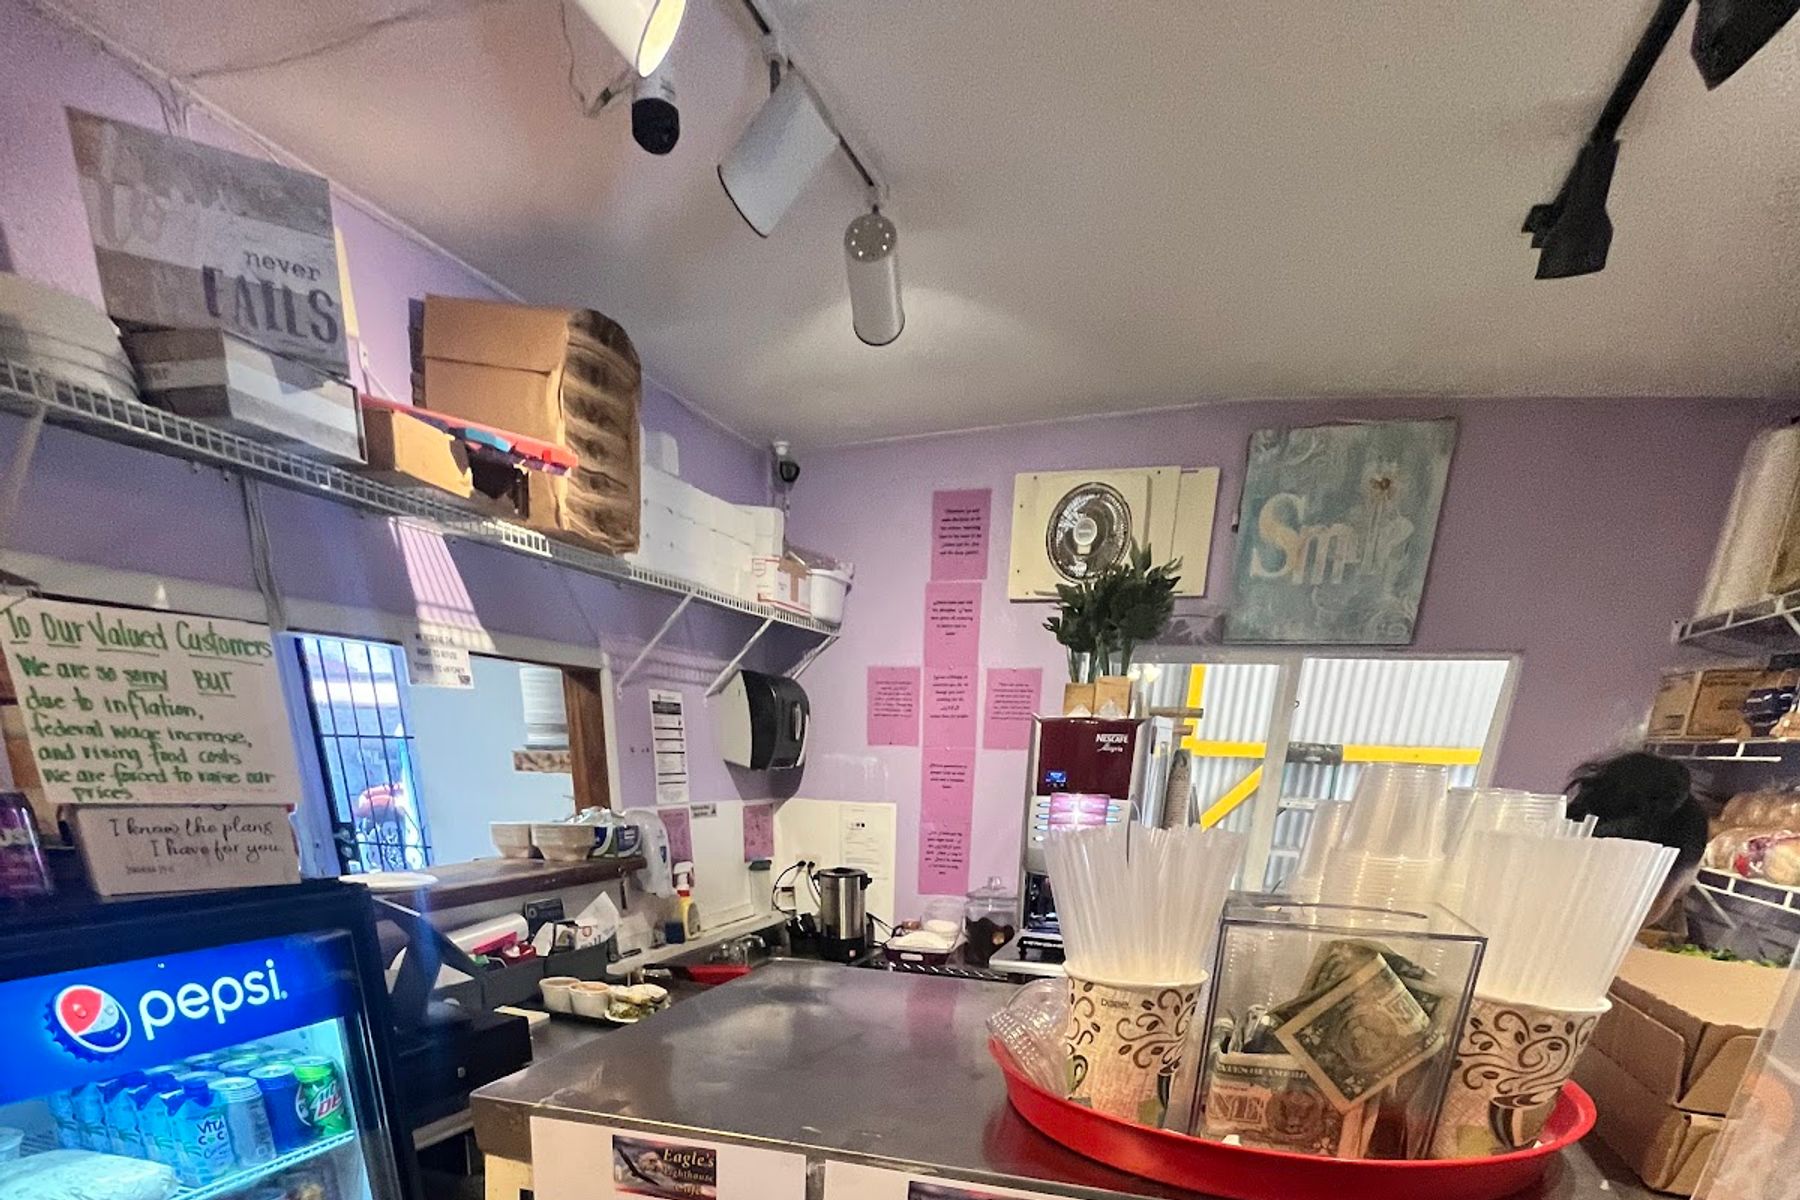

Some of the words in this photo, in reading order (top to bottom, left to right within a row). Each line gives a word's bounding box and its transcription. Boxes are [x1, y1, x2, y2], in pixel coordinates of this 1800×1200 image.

[243, 250, 321, 282] never
[202, 265, 338, 344] FAILS
[7, 609, 31, 639] To
[42, 612, 84, 642] Our
[91, 612, 168, 651] Valued
[176, 620, 273, 657] Customers
[16, 654, 50, 677] We
[57, 660, 89, 678] are
[96, 663, 117, 681] so
[123, 663, 168, 691] sorry
[192, 669, 233, 691] BUT
[26, 686, 66, 710] due
[72, 687, 93, 712] to
[31, 712, 104, 738] federal
[111, 724, 161, 744] wage
[39, 743, 76, 761] and
[81, 744, 141, 769] rising
[149, 742, 188, 766] food
[199, 749, 242, 766] costs
[42, 768, 72, 784] We
[76, 768, 105, 783] are
[113, 763, 168, 786] forced
[172, 766, 192, 784] to
[198, 771, 241, 784] raise
[245, 771, 275, 785] our
[109, 819, 121, 836] I
[127, 818, 180, 835] know
[185, 818, 218, 837] the
[221, 817, 273, 840] plans
[151, 841, 161, 857] I
[166, 841, 209, 857] have
[213, 842, 241, 861] for
[138, 959, 282, 1041] pepsi
[662, 1147, 715, 1168] Eagle's
